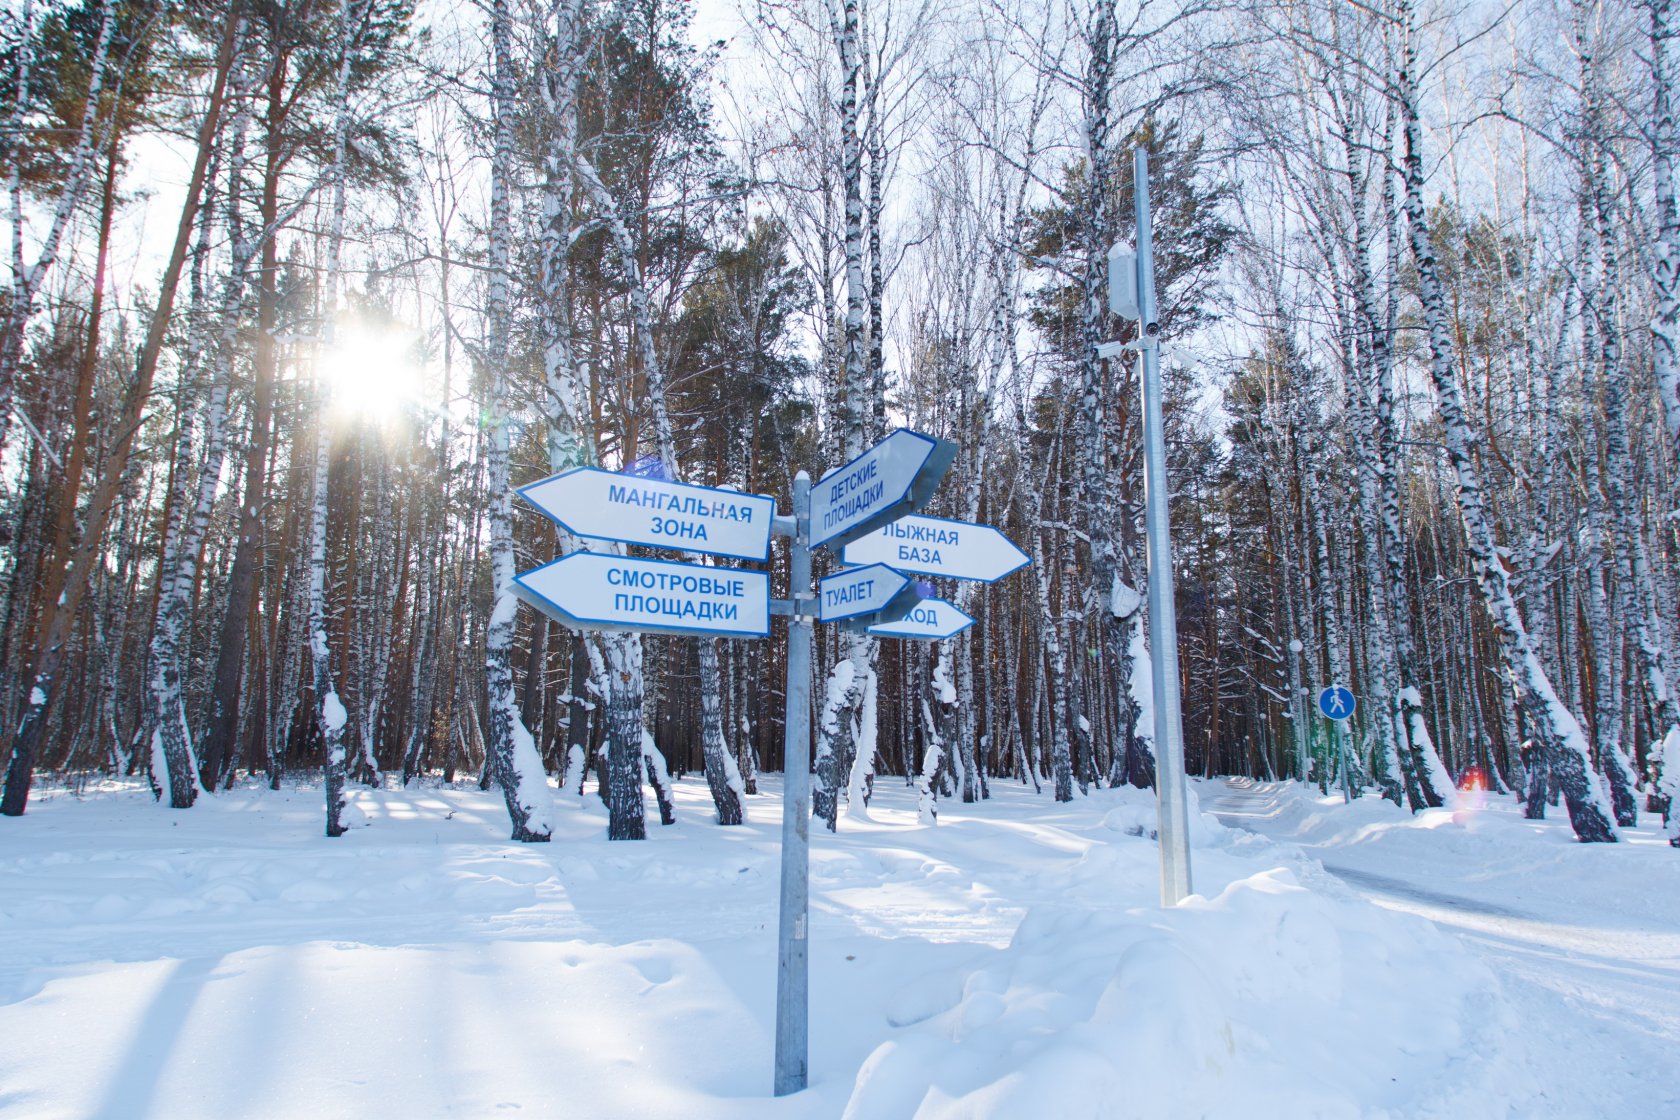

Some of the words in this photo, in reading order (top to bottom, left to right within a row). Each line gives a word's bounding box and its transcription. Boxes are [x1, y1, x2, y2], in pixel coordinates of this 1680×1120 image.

[830, 459, 877, 505] ДЕТСКИЕ
[608, 484, 753, 523] МАНГАЛЬНАЯ
[823, 480, 884, 530] ПЛОЩАДКИ
[650, 516, 708, 541] ЗОНА
[883, 522, 959, 546] ЛЫЖНАЯ
[898, 545, 942, 565] БАЗА
[607, 568, 744, 597] СМОТРОВЫЕ
[825, 580, 875, 607] ТУАЛЕТ
[615, 594, 737, 621] ПЛОЩАДКИ
